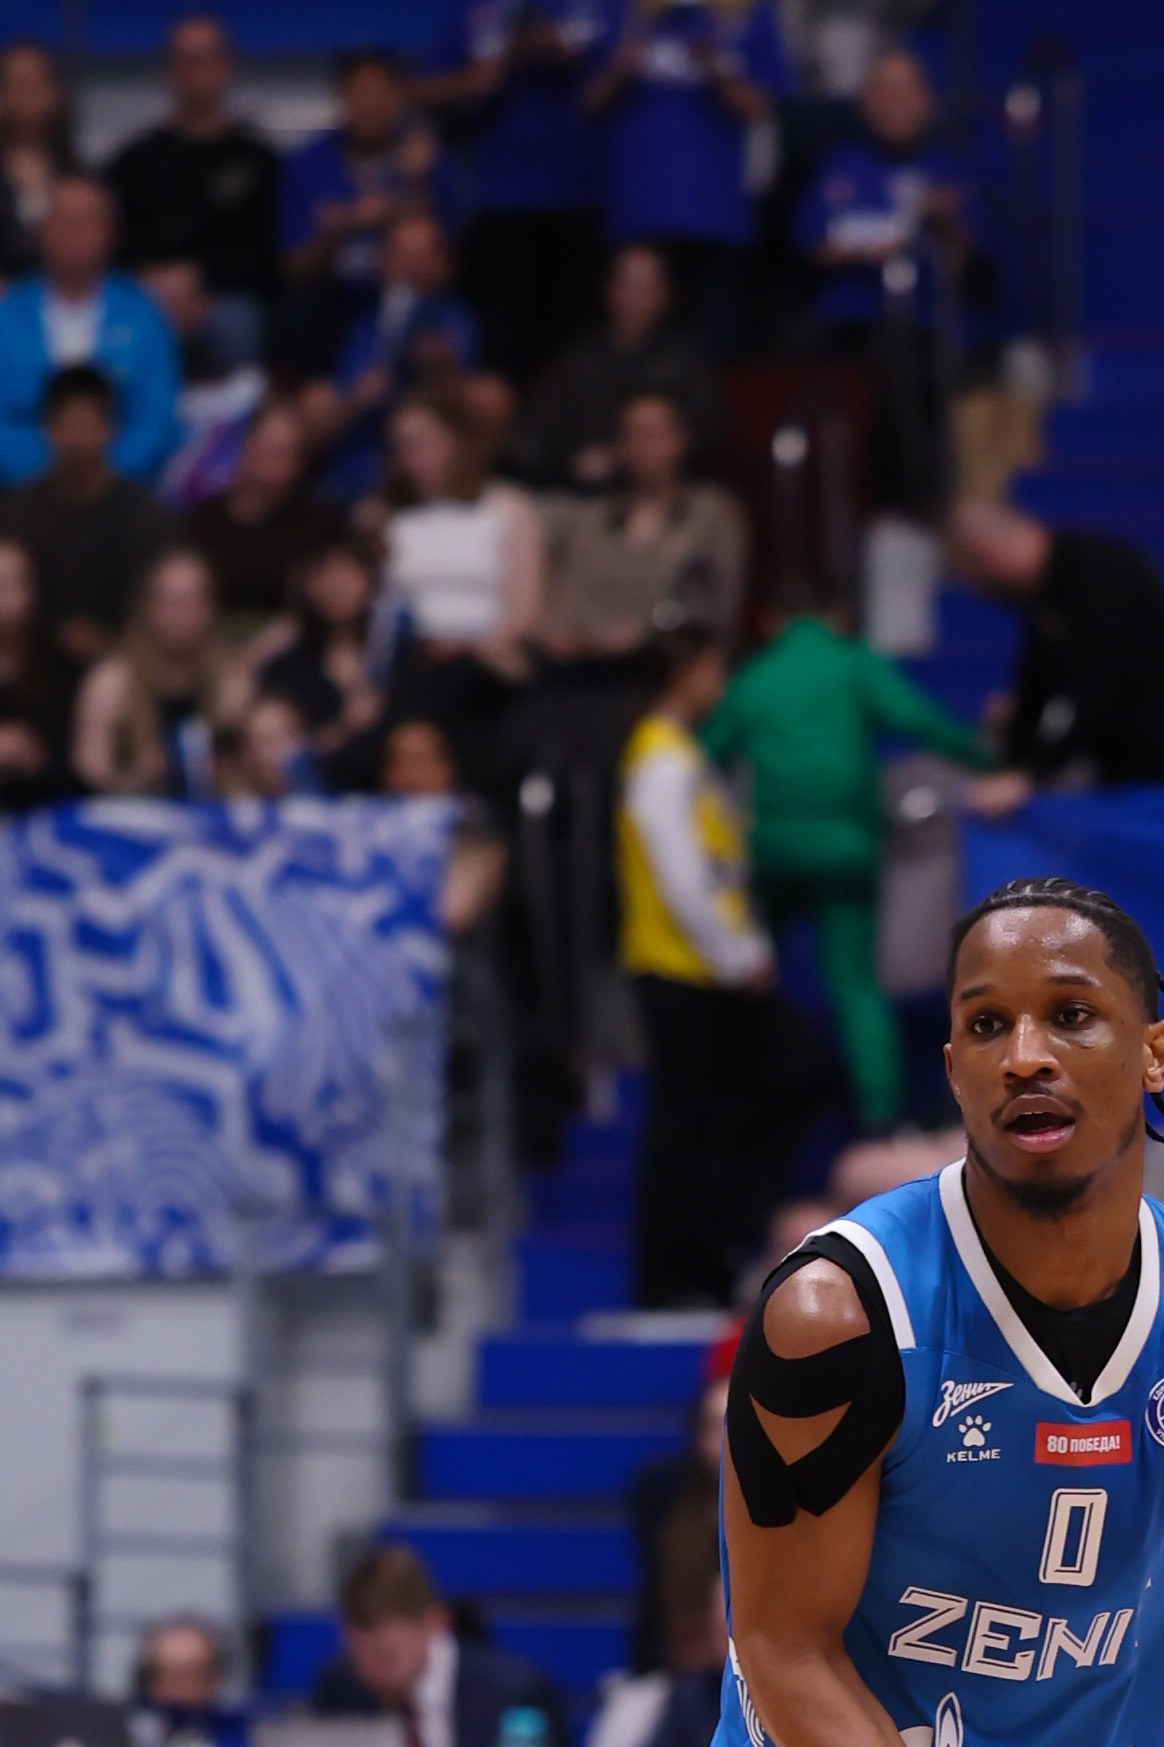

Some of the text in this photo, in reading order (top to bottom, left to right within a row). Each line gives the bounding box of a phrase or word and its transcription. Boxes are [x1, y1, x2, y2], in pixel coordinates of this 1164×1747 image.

[946, 1448, 1001, 1463] KELME
[1047, 1435, 1121, 1454] 80 ПОБЕДА!
[1039, 1488, 1108, 1586] 0
[888, 1585, 1136, 1681] ZENI
